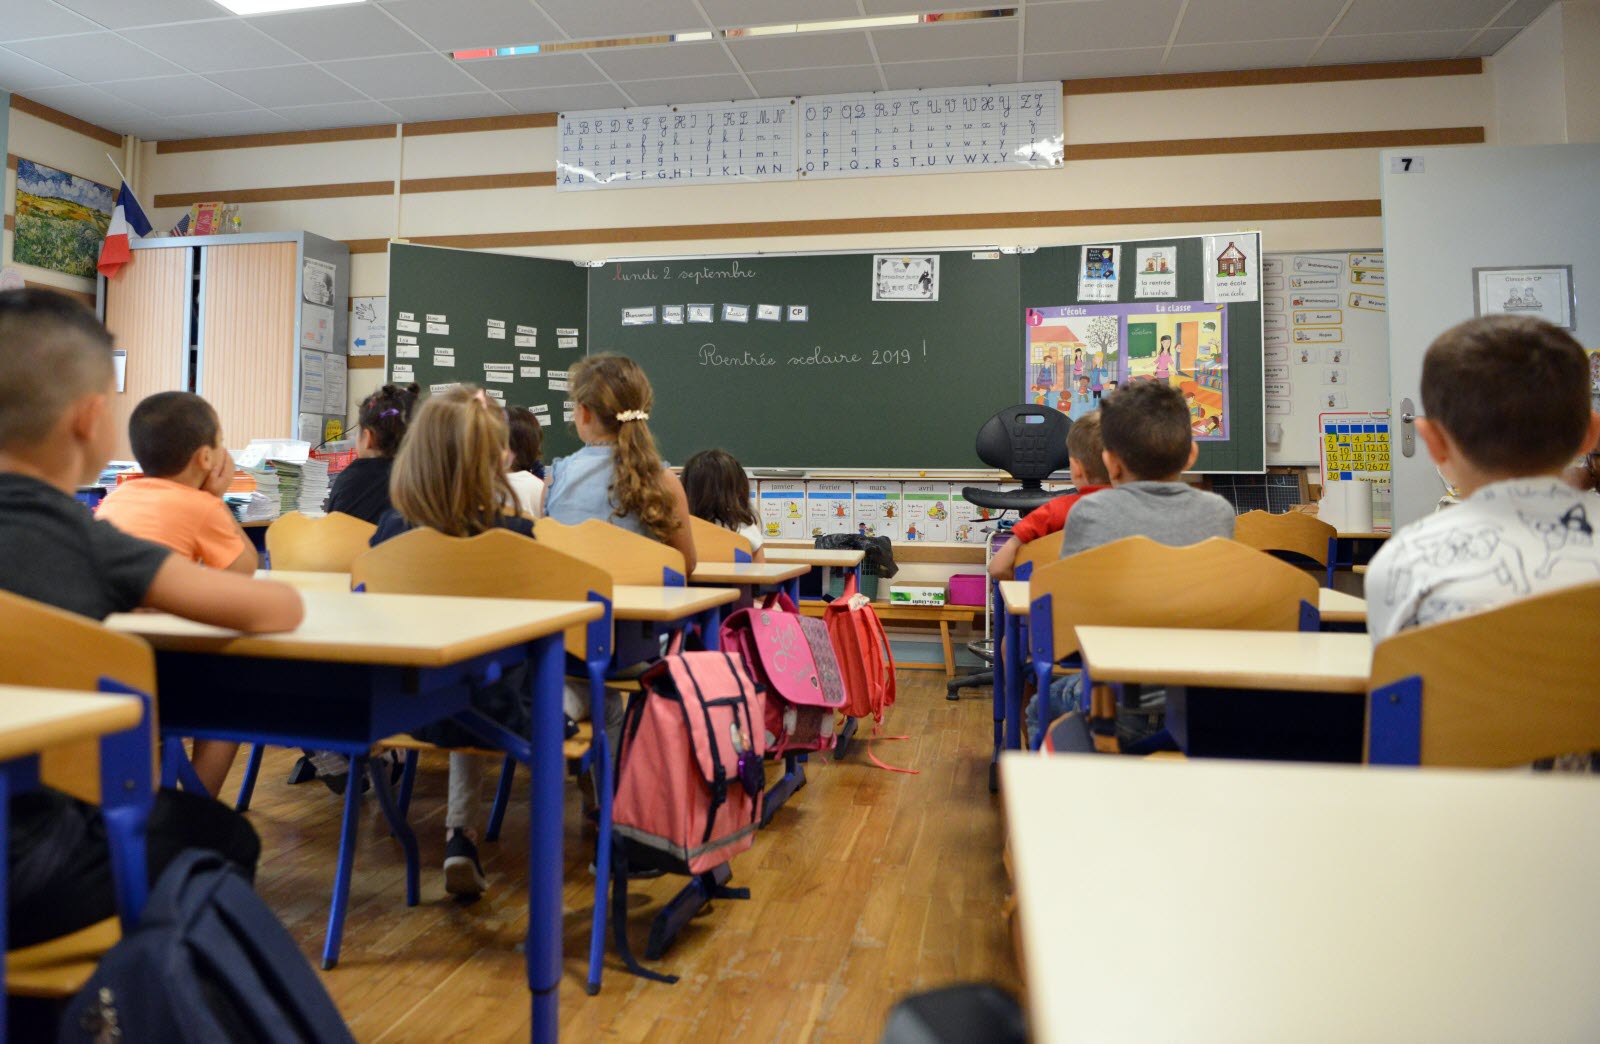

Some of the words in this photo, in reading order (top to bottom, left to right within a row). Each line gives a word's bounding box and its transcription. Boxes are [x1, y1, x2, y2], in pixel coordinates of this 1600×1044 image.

[806, 108, 816, 120] O
[823, 106, 832, 120] P
[875, 103, 888, 117] R
[892, 102, 901, 116] S
[910, 101, 919, 114] T
[928, 100, 941, 113] U
[945, 99, 956, 112] V
[963, 98, 977, 111] W
[981, 97, 994, 110] X
[999, 96, 1011, 117] Y
[1021, 95, 1031, 108] Z
[1035, 94, 1043, 116] Z
[564, 123, 573, 135] A
[580, 122, 589, 134] B
[595, 121, 602, 133] C
[611, 120, 620, 132] D
[627, 119, 634, 131] E
[642, 118, 650, 130] F
[659, 117, 668, 137] G
[675, 116, 686, 128] H
[691, 115, 696, 128] I
[708, 114, 714, 135] J
[723, 113, 735, 126] K
[740, 112, 748, 124] L
[756, 111, 769, 124] M
[773, 110, 785, 123] N
[806, 162, 814, 171] O
[823, 162, 829, 170] P
[850, 160, 858, 169] Q
[875, 159, 881, 168] R
[893, 158, 899, 167] S
[911, 157, 916, 166] T
[928, 156, 935, 165] U
[946, 155, 954, 164] V
[964, 155, 977, 163] W
[982, 154, 989, 163] X
[1000, 153, 1007, 162] Y
[1030, 152, 1036, 160] Z
[1402, 159, 1412, 171] 7
[563, 175, 571, 184] A
[579, 174, 584, 182] B
[626, 172, 631, 180] E
[642, 171, 646, 179] F
[658, 170, 666, 179] G
[674, 169, 681, 178] H
[707, 168, 711, 176] J
[723, 166, 729, 175] K
[740, 166, 744, 175] L
[756, 165, 766, 174] M
[773, 164, 781, 173] N
[613, 264, 658, 280] lundi
[664, 267, 671, 279] 2
[679, 261, 755, 284] septembre
[1033, 316, 1038, 324] 1
[699, 343, 776, 366] Rentrée
[787, 346, 862, 365] scolaire
[871, 349, 911, 365] 2019
[923, 339, 927, 362] !
